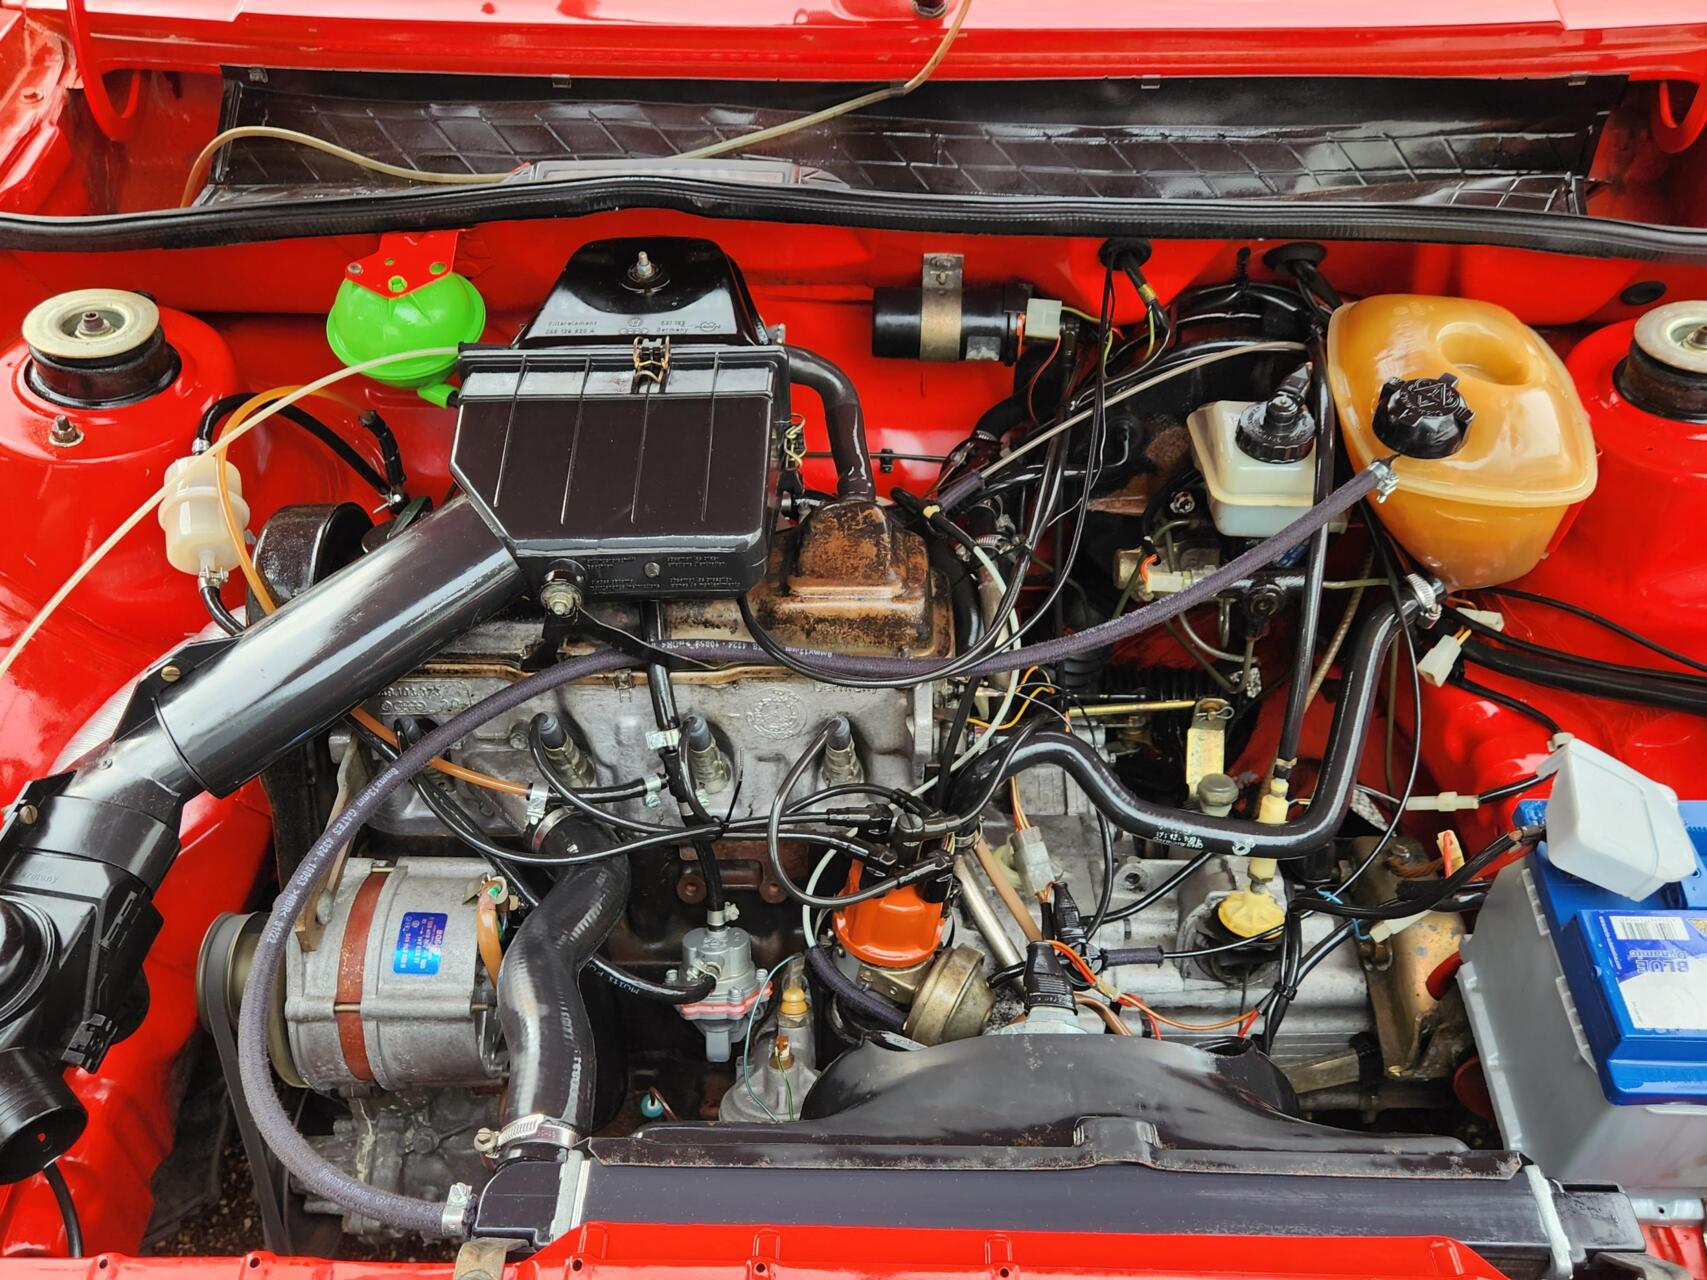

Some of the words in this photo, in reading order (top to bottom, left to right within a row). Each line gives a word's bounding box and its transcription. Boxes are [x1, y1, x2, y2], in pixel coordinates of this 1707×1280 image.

[332, 808, 357, 836] GATES
[1629, 949, 1687, 960] Dynamic
[1635, 959, 1689, 973] BLUE
